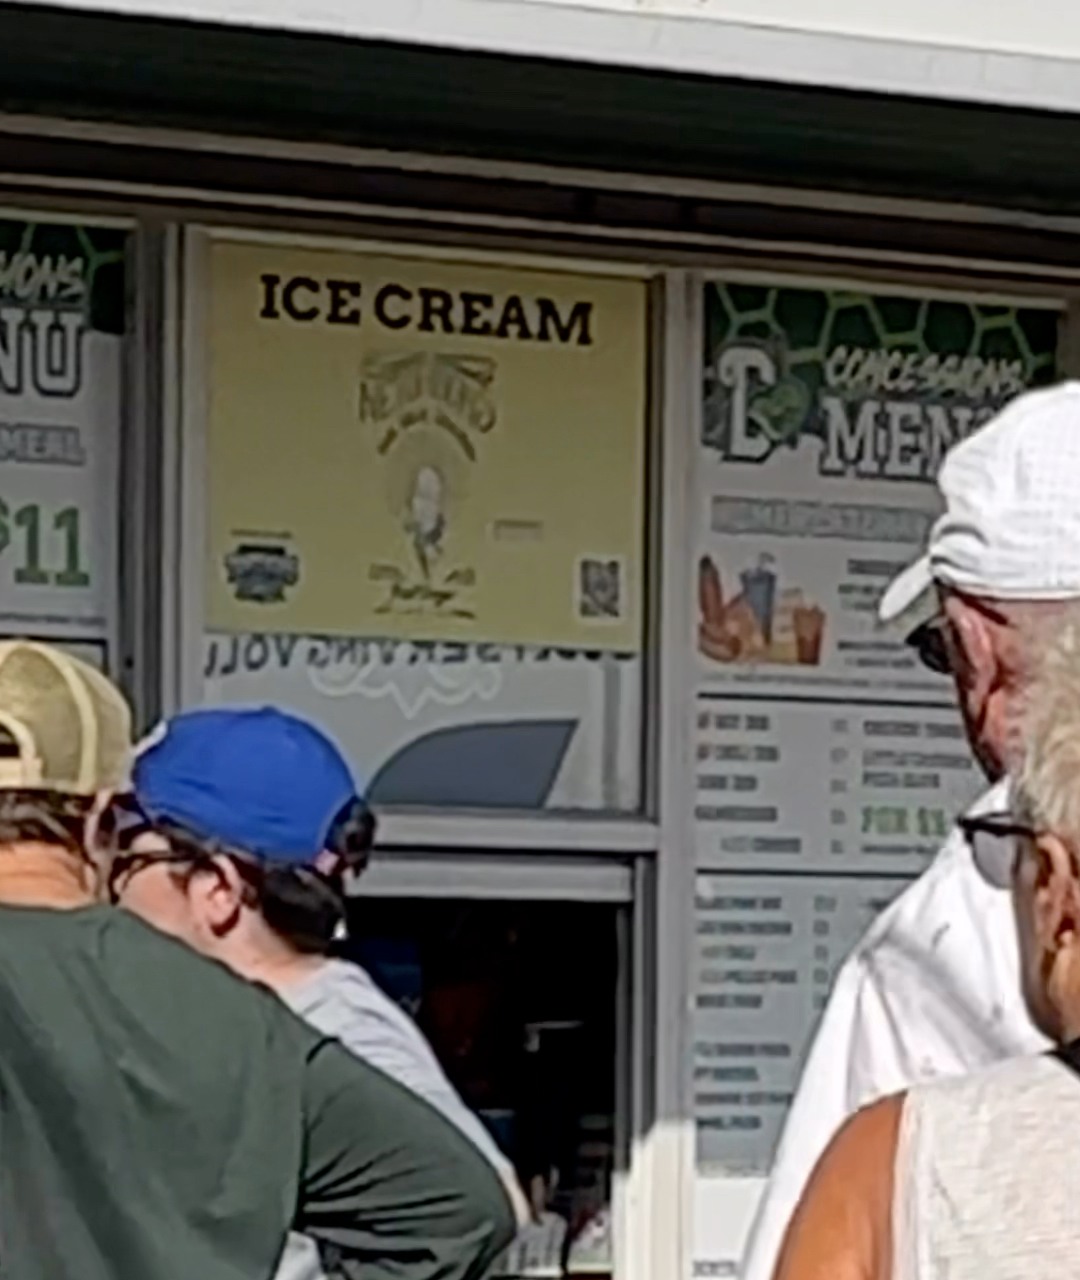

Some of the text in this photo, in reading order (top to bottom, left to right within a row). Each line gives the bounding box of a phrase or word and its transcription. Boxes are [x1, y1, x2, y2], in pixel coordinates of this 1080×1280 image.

[259, 273, 595, 347] ICE CREAM
[821, 394, 994, 484] MEN
